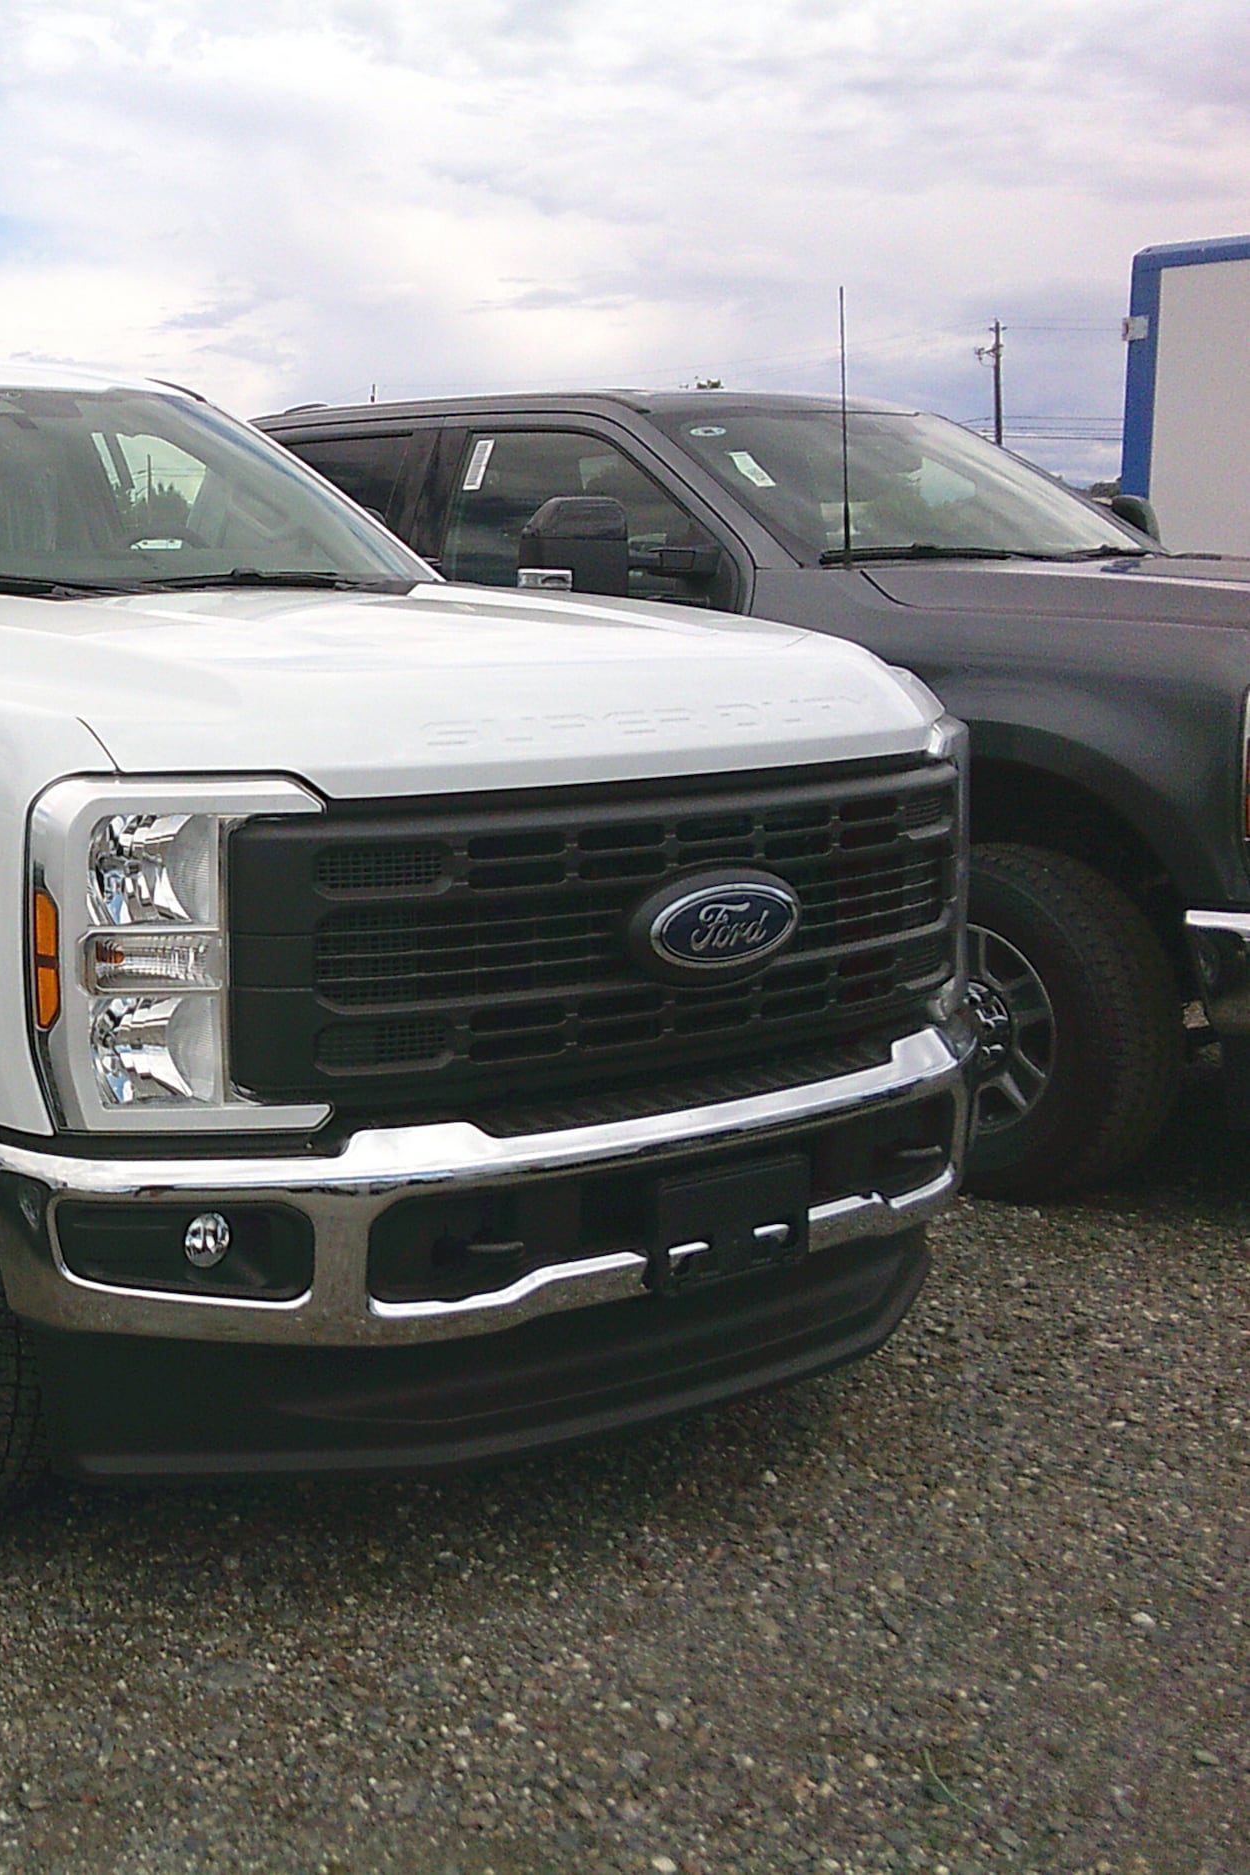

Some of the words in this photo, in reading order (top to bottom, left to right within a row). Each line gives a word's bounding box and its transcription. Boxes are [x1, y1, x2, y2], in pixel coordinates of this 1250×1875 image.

[419, 708, 708, 746] SUPER
[714, 694, 870, 728] DUTY
[691, 902, 770, 951] Ford
